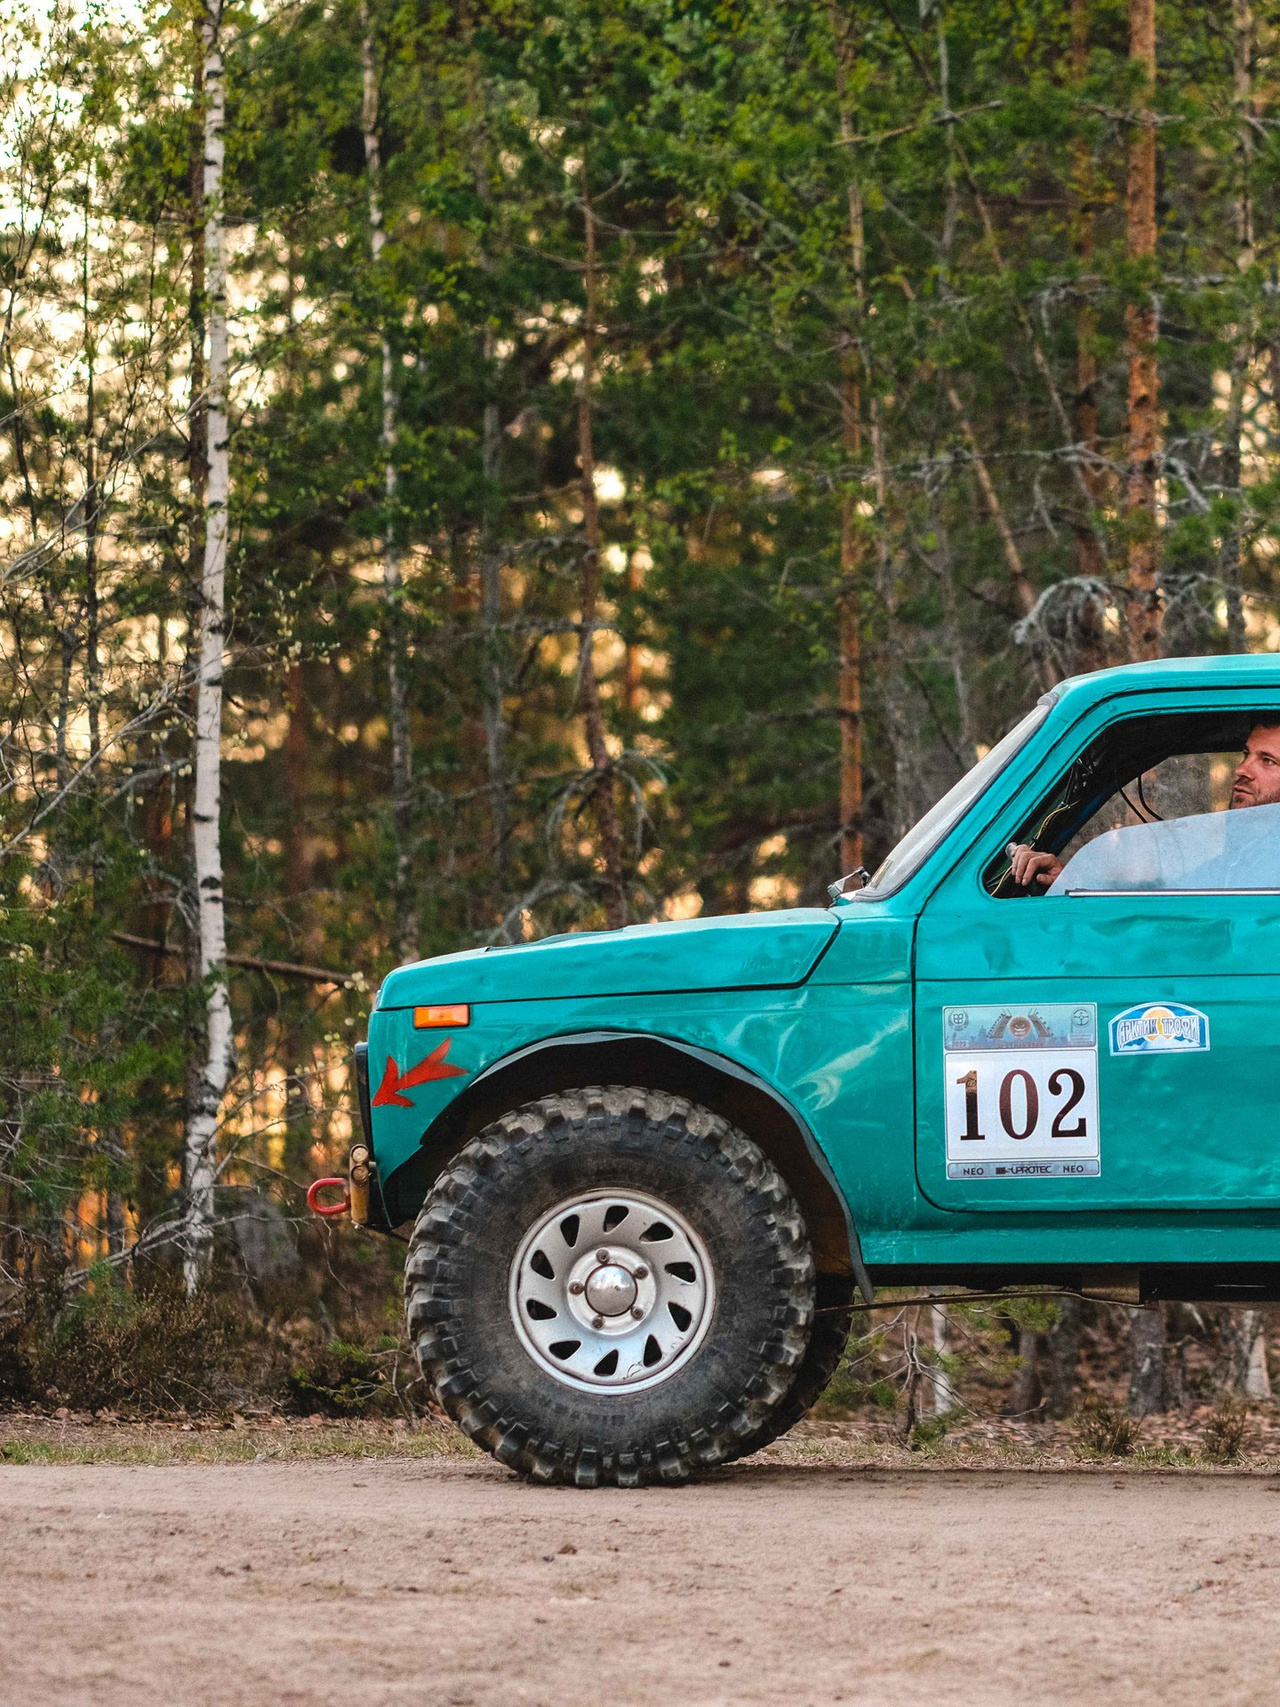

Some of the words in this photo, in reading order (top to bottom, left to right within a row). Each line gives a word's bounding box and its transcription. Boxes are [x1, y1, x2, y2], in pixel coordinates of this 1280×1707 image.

[1117, 1018, 1158, 1048] АРКТИК
[1161, 1015, 1200, 1043] ТРОФИ
[956, 1068, 1087, 1141] 102
[962, 1167, 984, 1176] NEO
[1062, 1164, 1084, 1173] NEO
